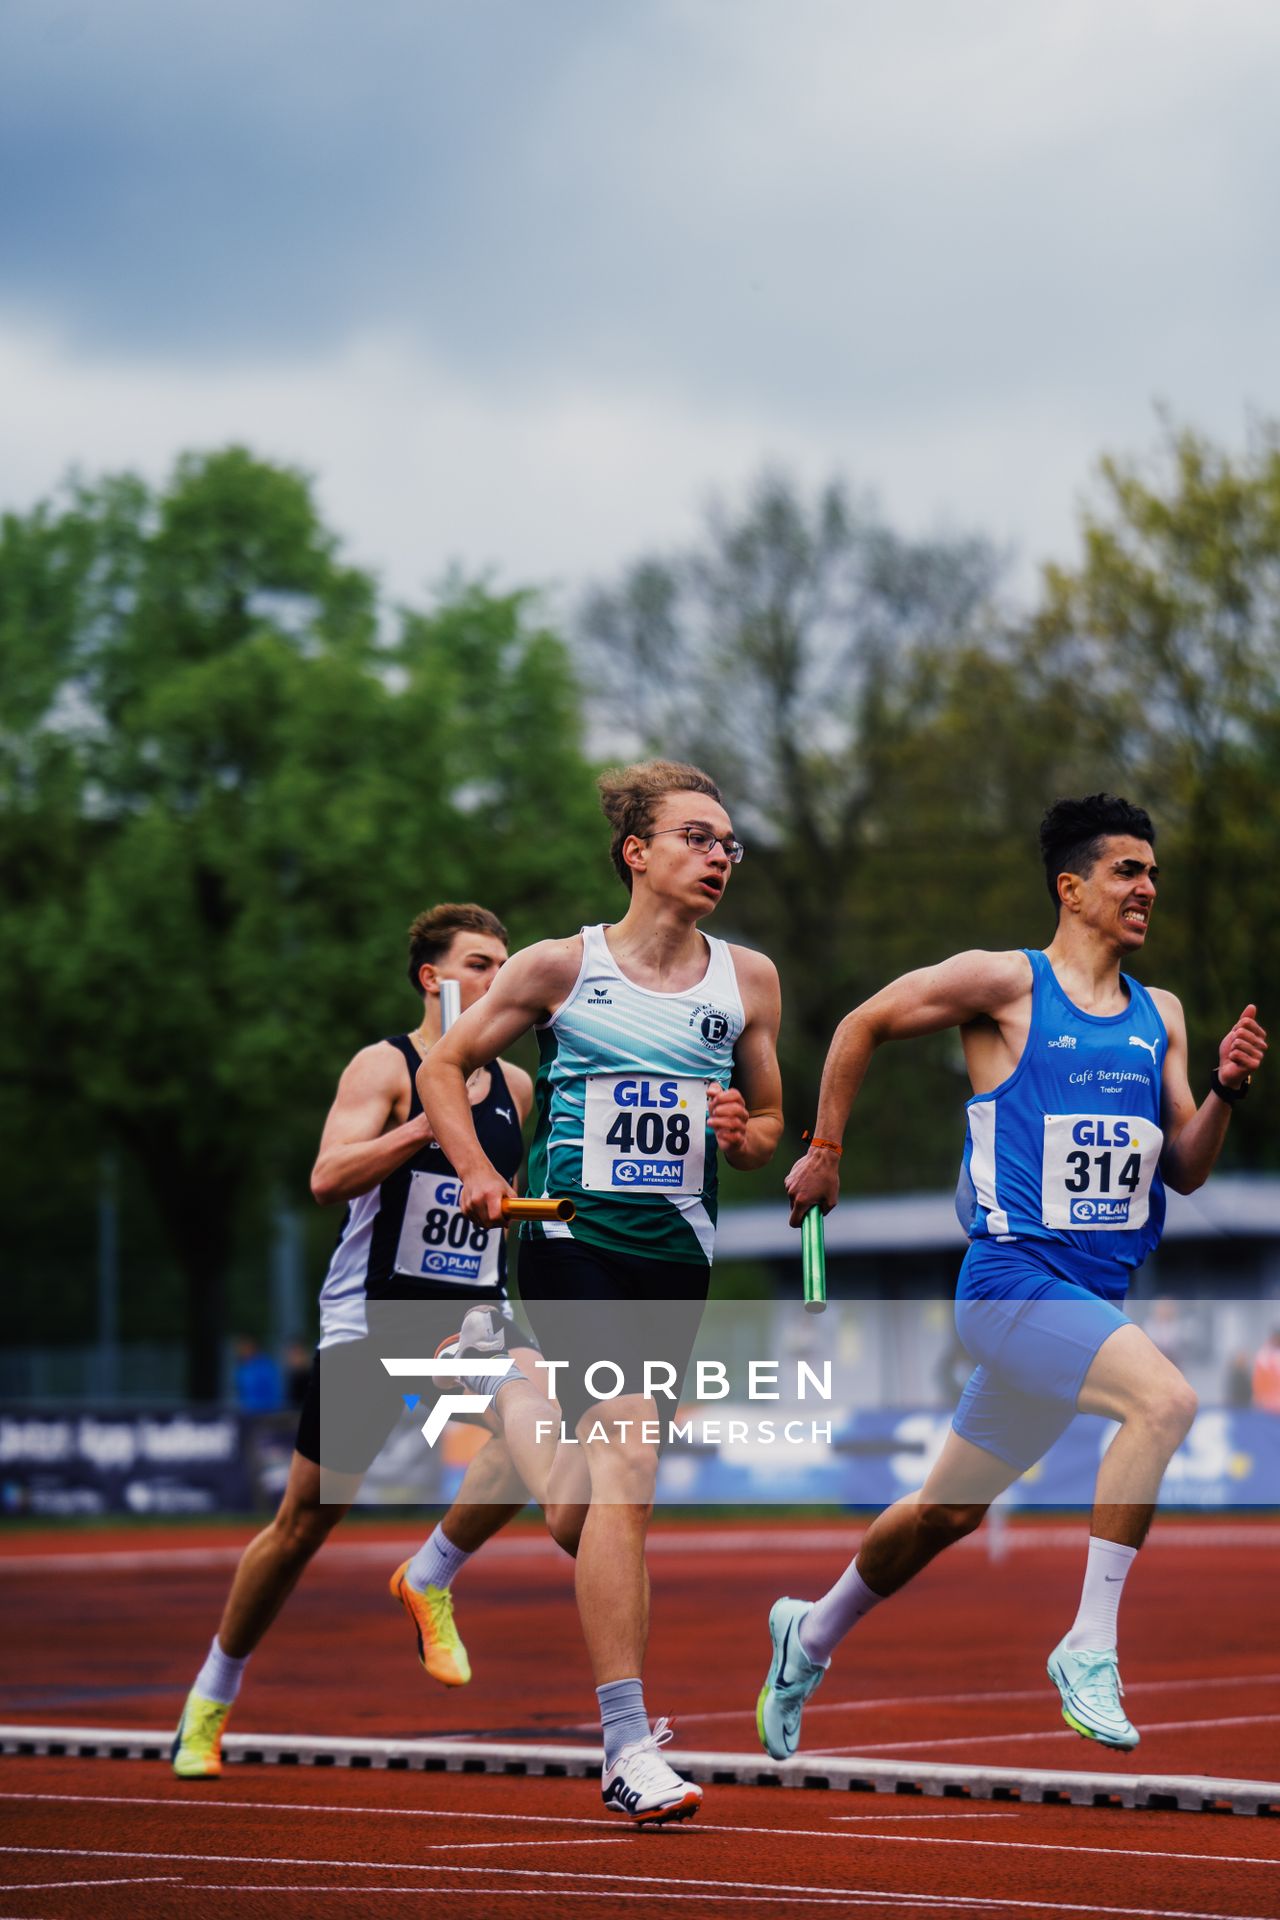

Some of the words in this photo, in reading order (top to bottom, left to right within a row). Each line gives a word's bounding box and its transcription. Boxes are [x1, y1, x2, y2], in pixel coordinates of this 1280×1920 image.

[587, 997, 612, 1005] erima
[707, 1016, 725, 1041] E
[1069, 1069, 1093, 1086] Café
[1096, 1069, 1151, 1086] Benjamin
[1100, 1086, 1123, 1094] Trebur
[606, 1112, 691, 1156] 408
[643, 1164, 681, 1178] PLAN
[1064, 1150, 1142, 1193] 314
[1098, 1202, 1128, 1215] PLAN
[422, 1208, 489, 1252] 808
[448, 1256, 480, 1271] PLAN
